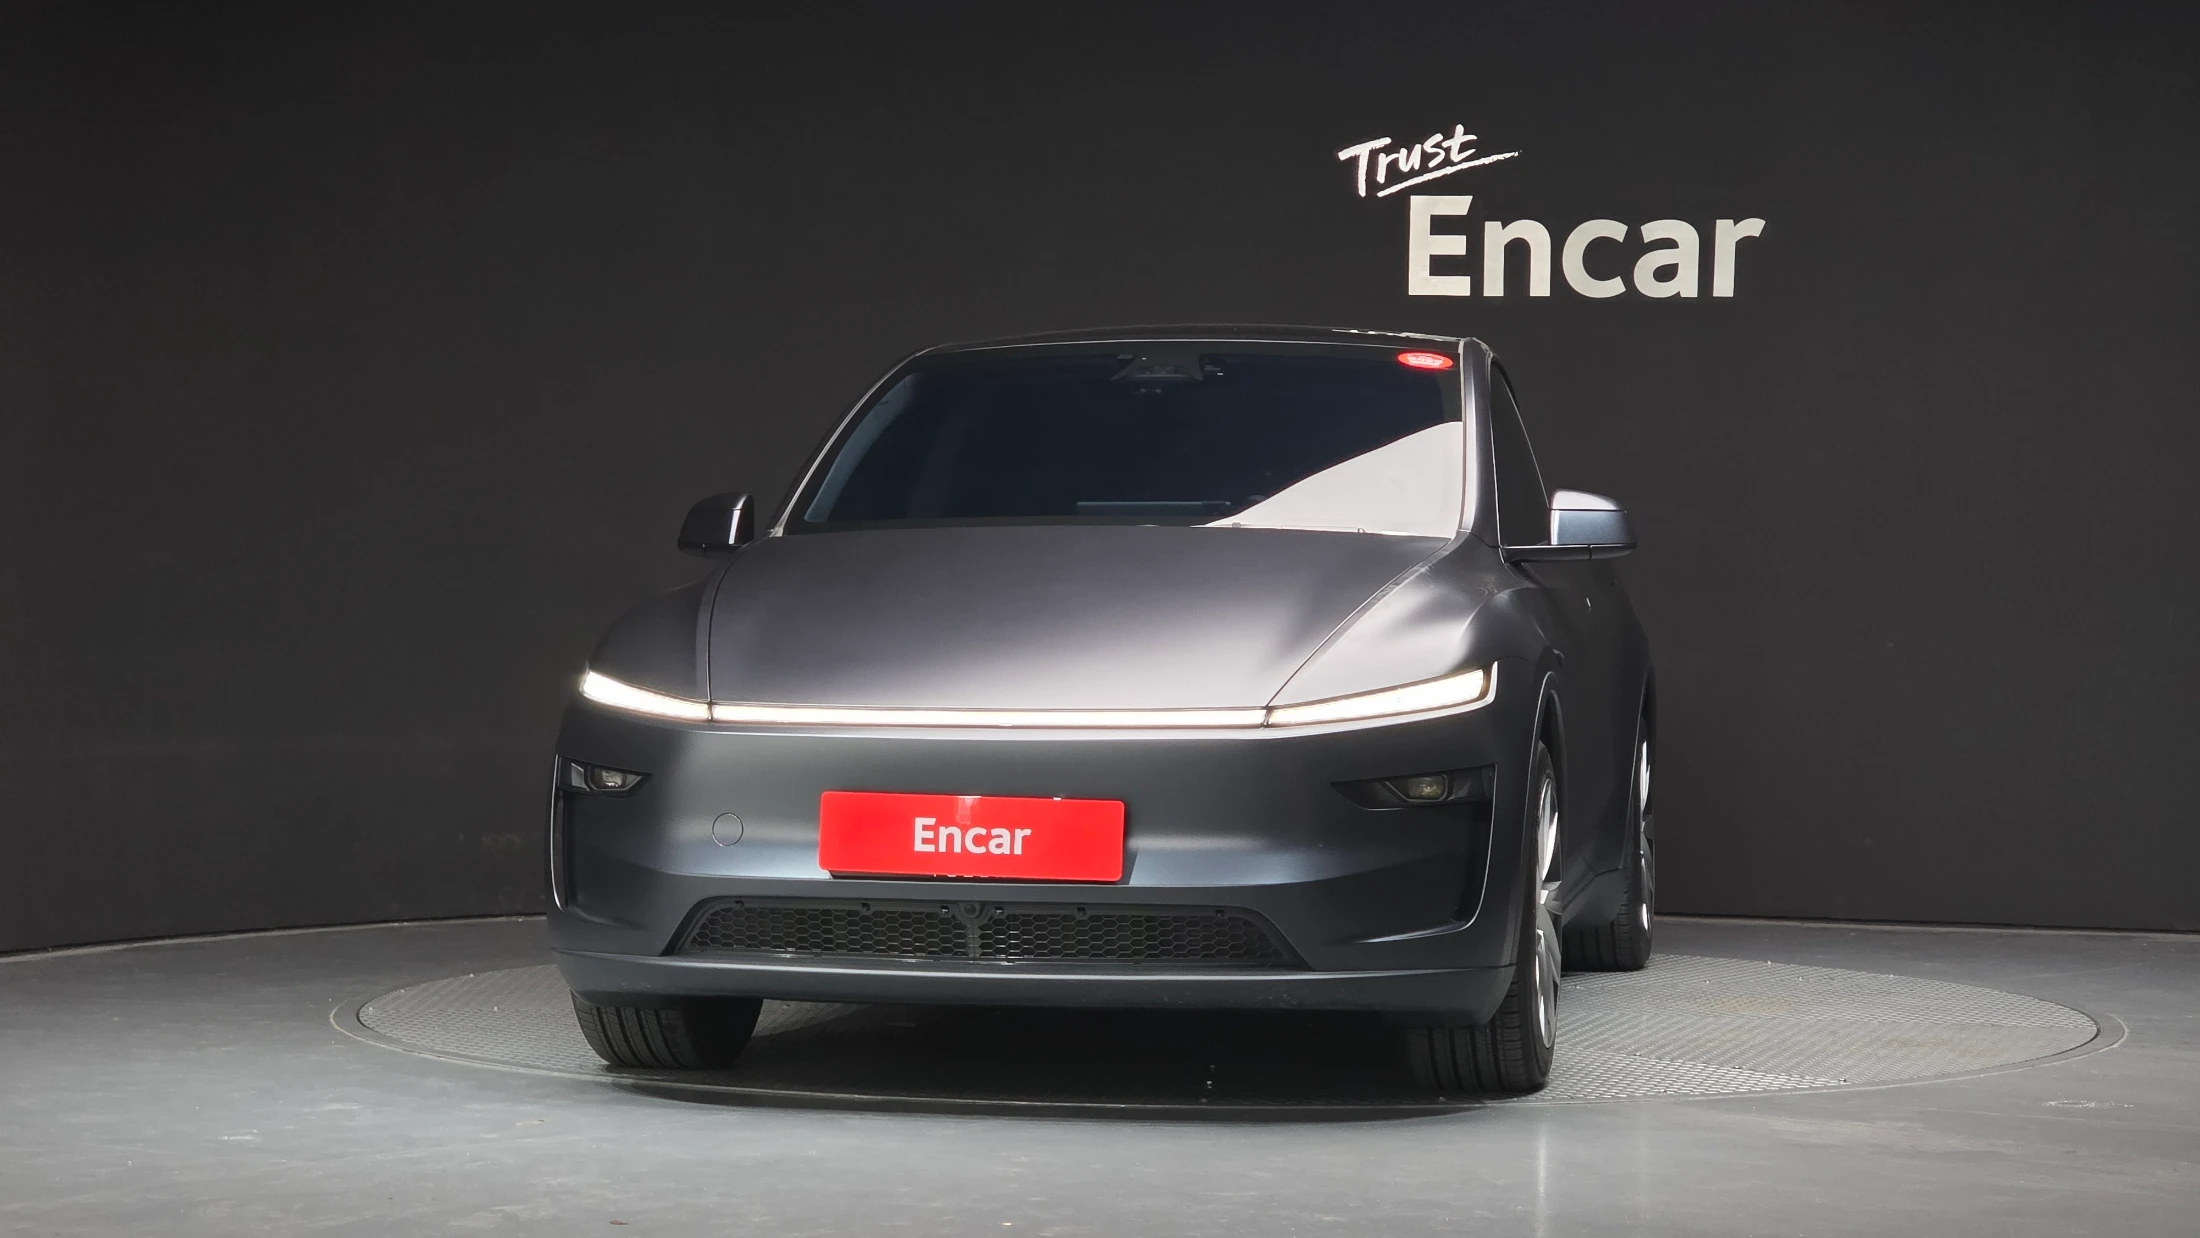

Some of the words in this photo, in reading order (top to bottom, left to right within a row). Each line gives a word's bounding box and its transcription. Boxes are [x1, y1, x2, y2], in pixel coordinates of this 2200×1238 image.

[1338, 124, 1484, 197] Trust
[1408, 195, 1766, 298] Encar
[913, 817, 1032, 855] Encar
